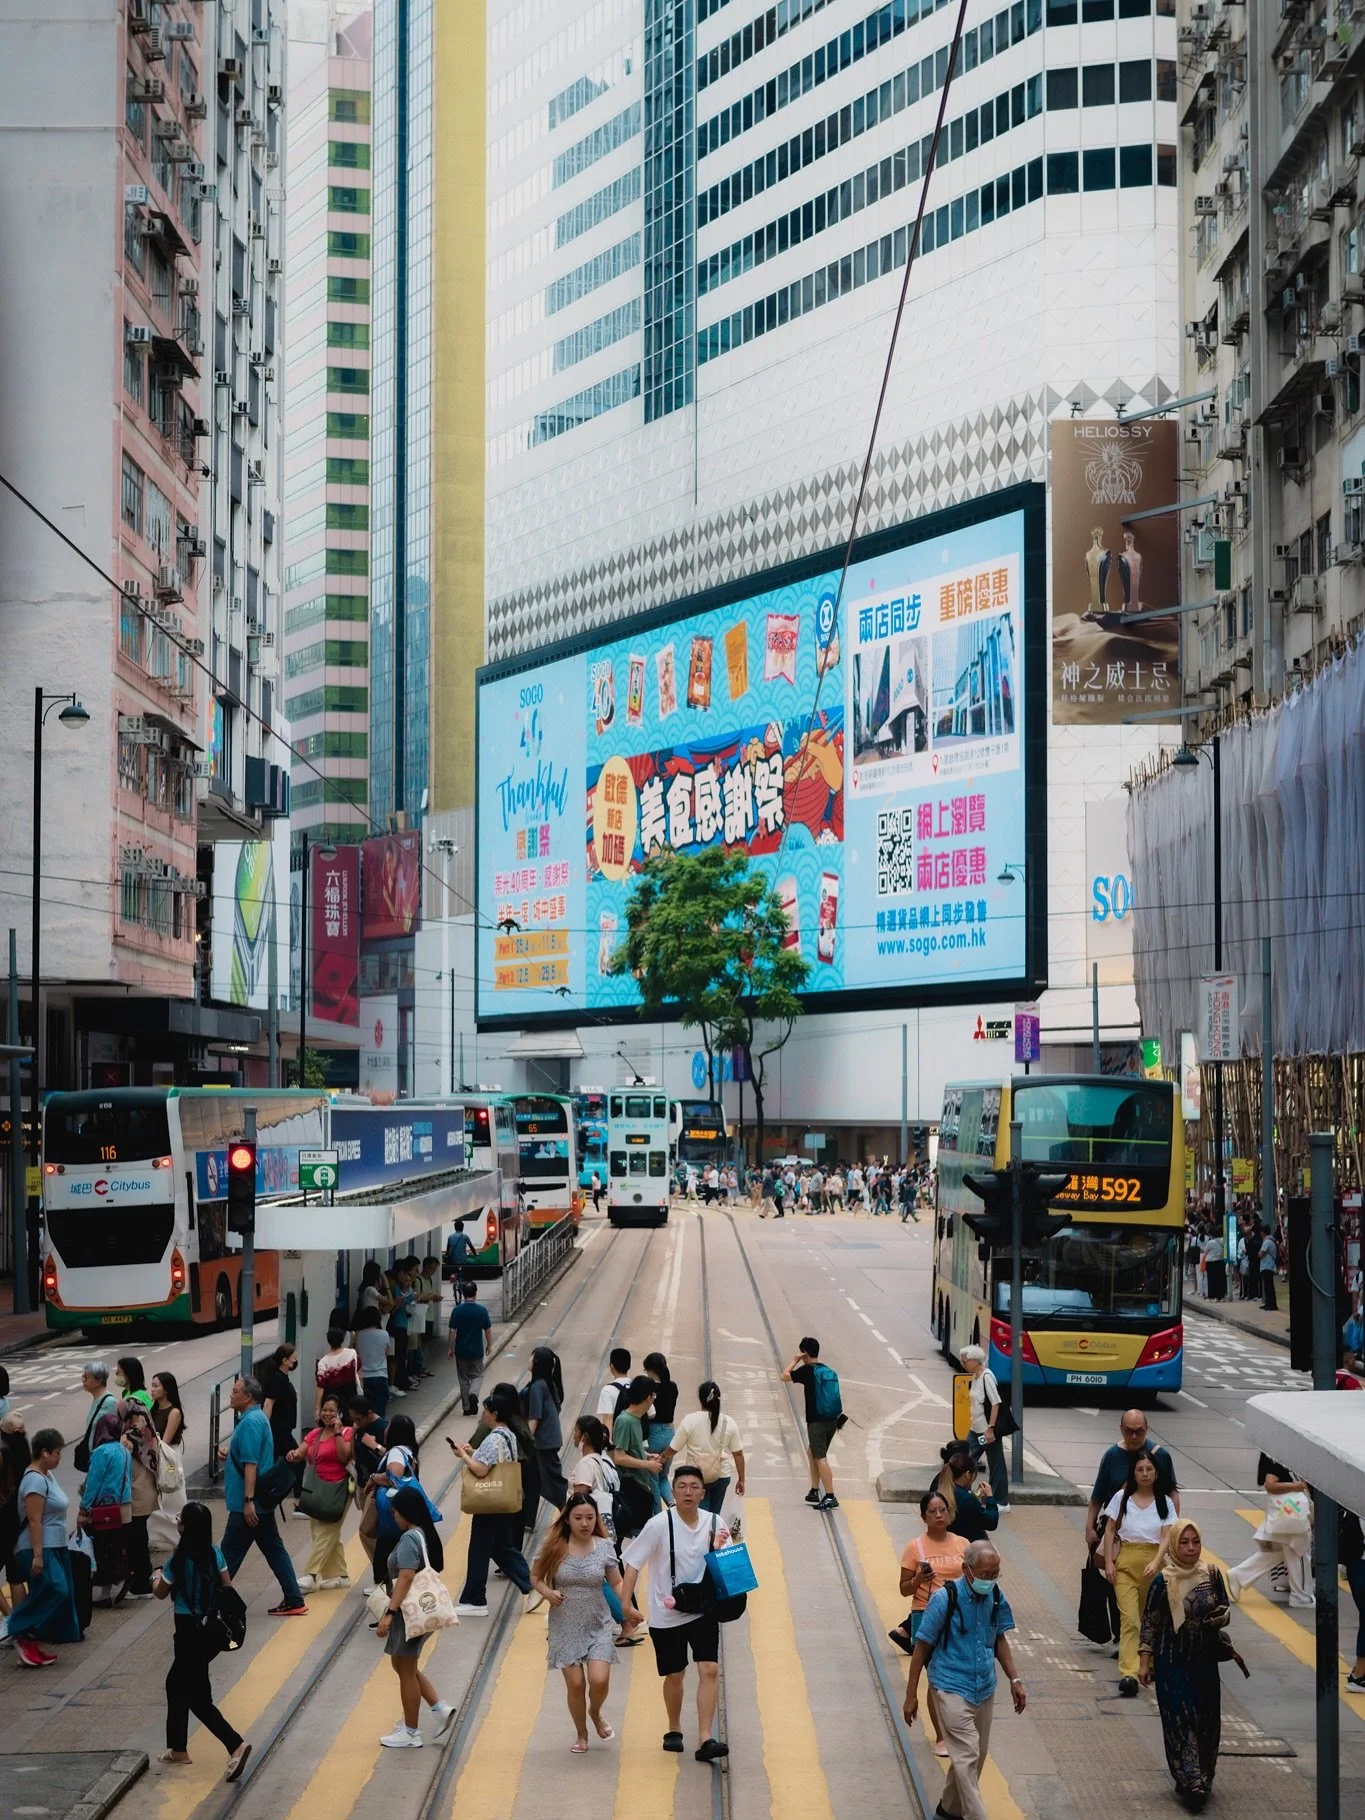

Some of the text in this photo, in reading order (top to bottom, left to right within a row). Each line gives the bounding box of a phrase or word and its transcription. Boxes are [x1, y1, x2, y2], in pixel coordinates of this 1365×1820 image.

[1074, 426, 1153, 438] HELIOSSY
[858, 567, 1009, 645] 兩店同步 重磅優惠
[1059, 660, 1171, 691] 神之威士忌
[519, 683, 543, 708] SOGO
[496, 760, 568, 832] Thankful
[640, 753, 785, 854] 美食感謝祭
[916, 794, 986, 841] 網上瀏覽
[602, 832, 625, 866] 加碼
[916, 847, 987, 892] 兩店優惠
[1093, 874, 1135, 922] SO
[877, 927, 986, 957] www.sogo.com.hk
[100, 1144, 117, 1160] 116
[70, 1183, 93, 1195] 城巴
[110, 1180, 151, 1192] Citybus
[1083, 1191, 1100, 1201] Bay
[1101, 1177, 1142, 1202] 592
[1090, 1340, 1117, 1349] Citybus
